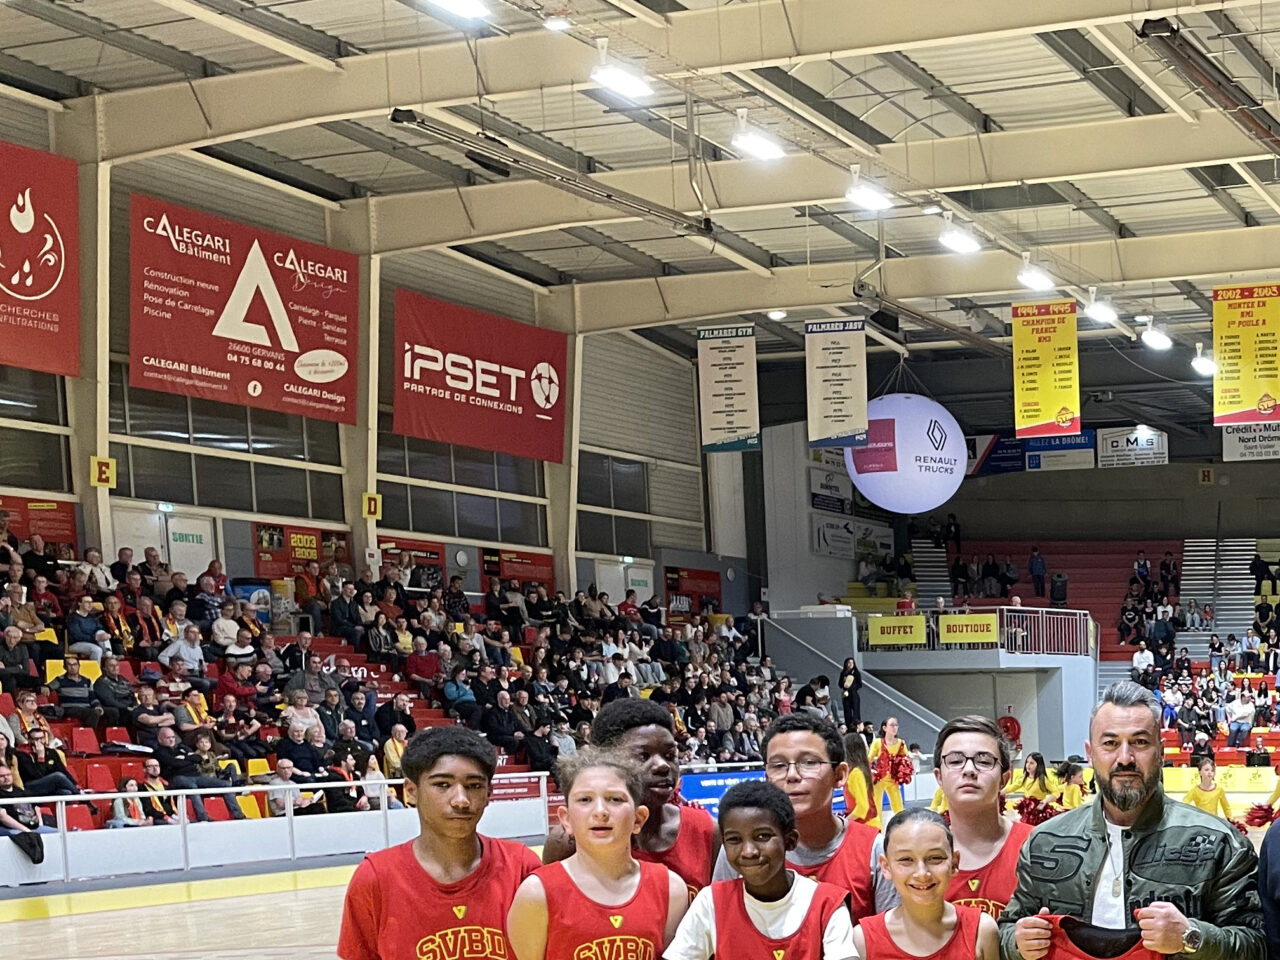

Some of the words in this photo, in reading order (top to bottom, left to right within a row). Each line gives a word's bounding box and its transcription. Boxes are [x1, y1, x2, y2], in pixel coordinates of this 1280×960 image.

[143, 212, 231, 254] CALEGARI
[178, 242, 232, 266] Bâtiment
[273, 248, 348, 284] CALEGARI
[143, 266, 195, 287] Construction
[143, 292, 164, 306] Pose
[165, 297, 176, 308] de
[1217, 289, 1242, 300] 2002
[1253, 286, 1278, 298] 2003
[143, 306, 173, 320] Piscine
[1017, 305, 1038, 317] 1994
[1049, 303, 1072, 315] 1995
[1238, 319, 1260, 328] POULE
[227, 342, 251, 355] 26600
[251, 346, 286, 362] GERVANS
[142, 355, 189, 373] CALEGARI
[190, 363, 232, 381] Bâtiment
[227, 353, 239, 364] 04
[239, 355, 250, 366] 75
[263, 359, 274, 370] 00
[275, 361, 286, 373] 44
[283, 383, 321, 398] CALEGARI
[321, 391, 346, 404] Design
[403, 381, 451, 400] PARTAGE
[454, 392, 467, 403] DE
[469, 395, 523, 414] CONNEXIONS
[1225, 423, 1252, 435] Crédit
[1238, 435, 1257, 444] Nord
[914, 455, 958, 466] RENAULT
[97, 461, 111, 484] E
[918, 465, 955, 475] TRUCKS
[1201, 470, 1211, 483] H
[367, 496, 378, 516] D
[172, 531, 205, 545] SORTIE
[290, 533, 318, 549] 2003
[879, 624, 914, 636] BUFFET
[946, 623, 992, 634] BOUTIQUE
